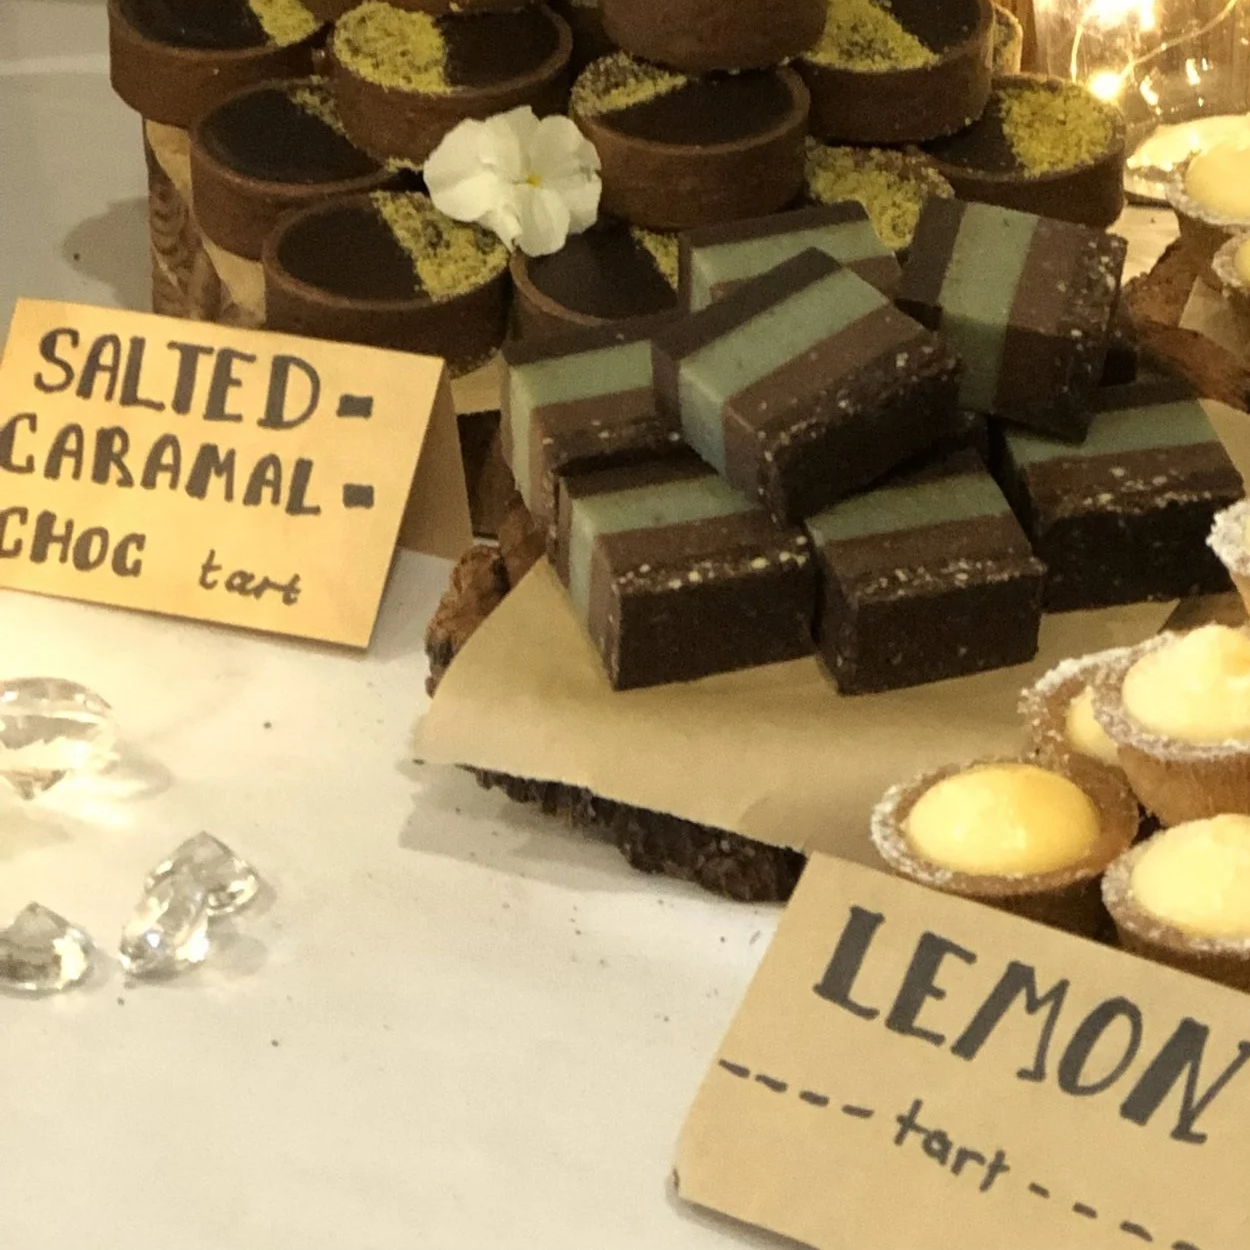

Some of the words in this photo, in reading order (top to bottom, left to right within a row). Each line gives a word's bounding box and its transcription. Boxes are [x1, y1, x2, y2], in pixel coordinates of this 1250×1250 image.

[0, 506, 147, 578] CHOC
[198, 548, 302, 606] tart
[893, 1098, 1011, 1193] tart
